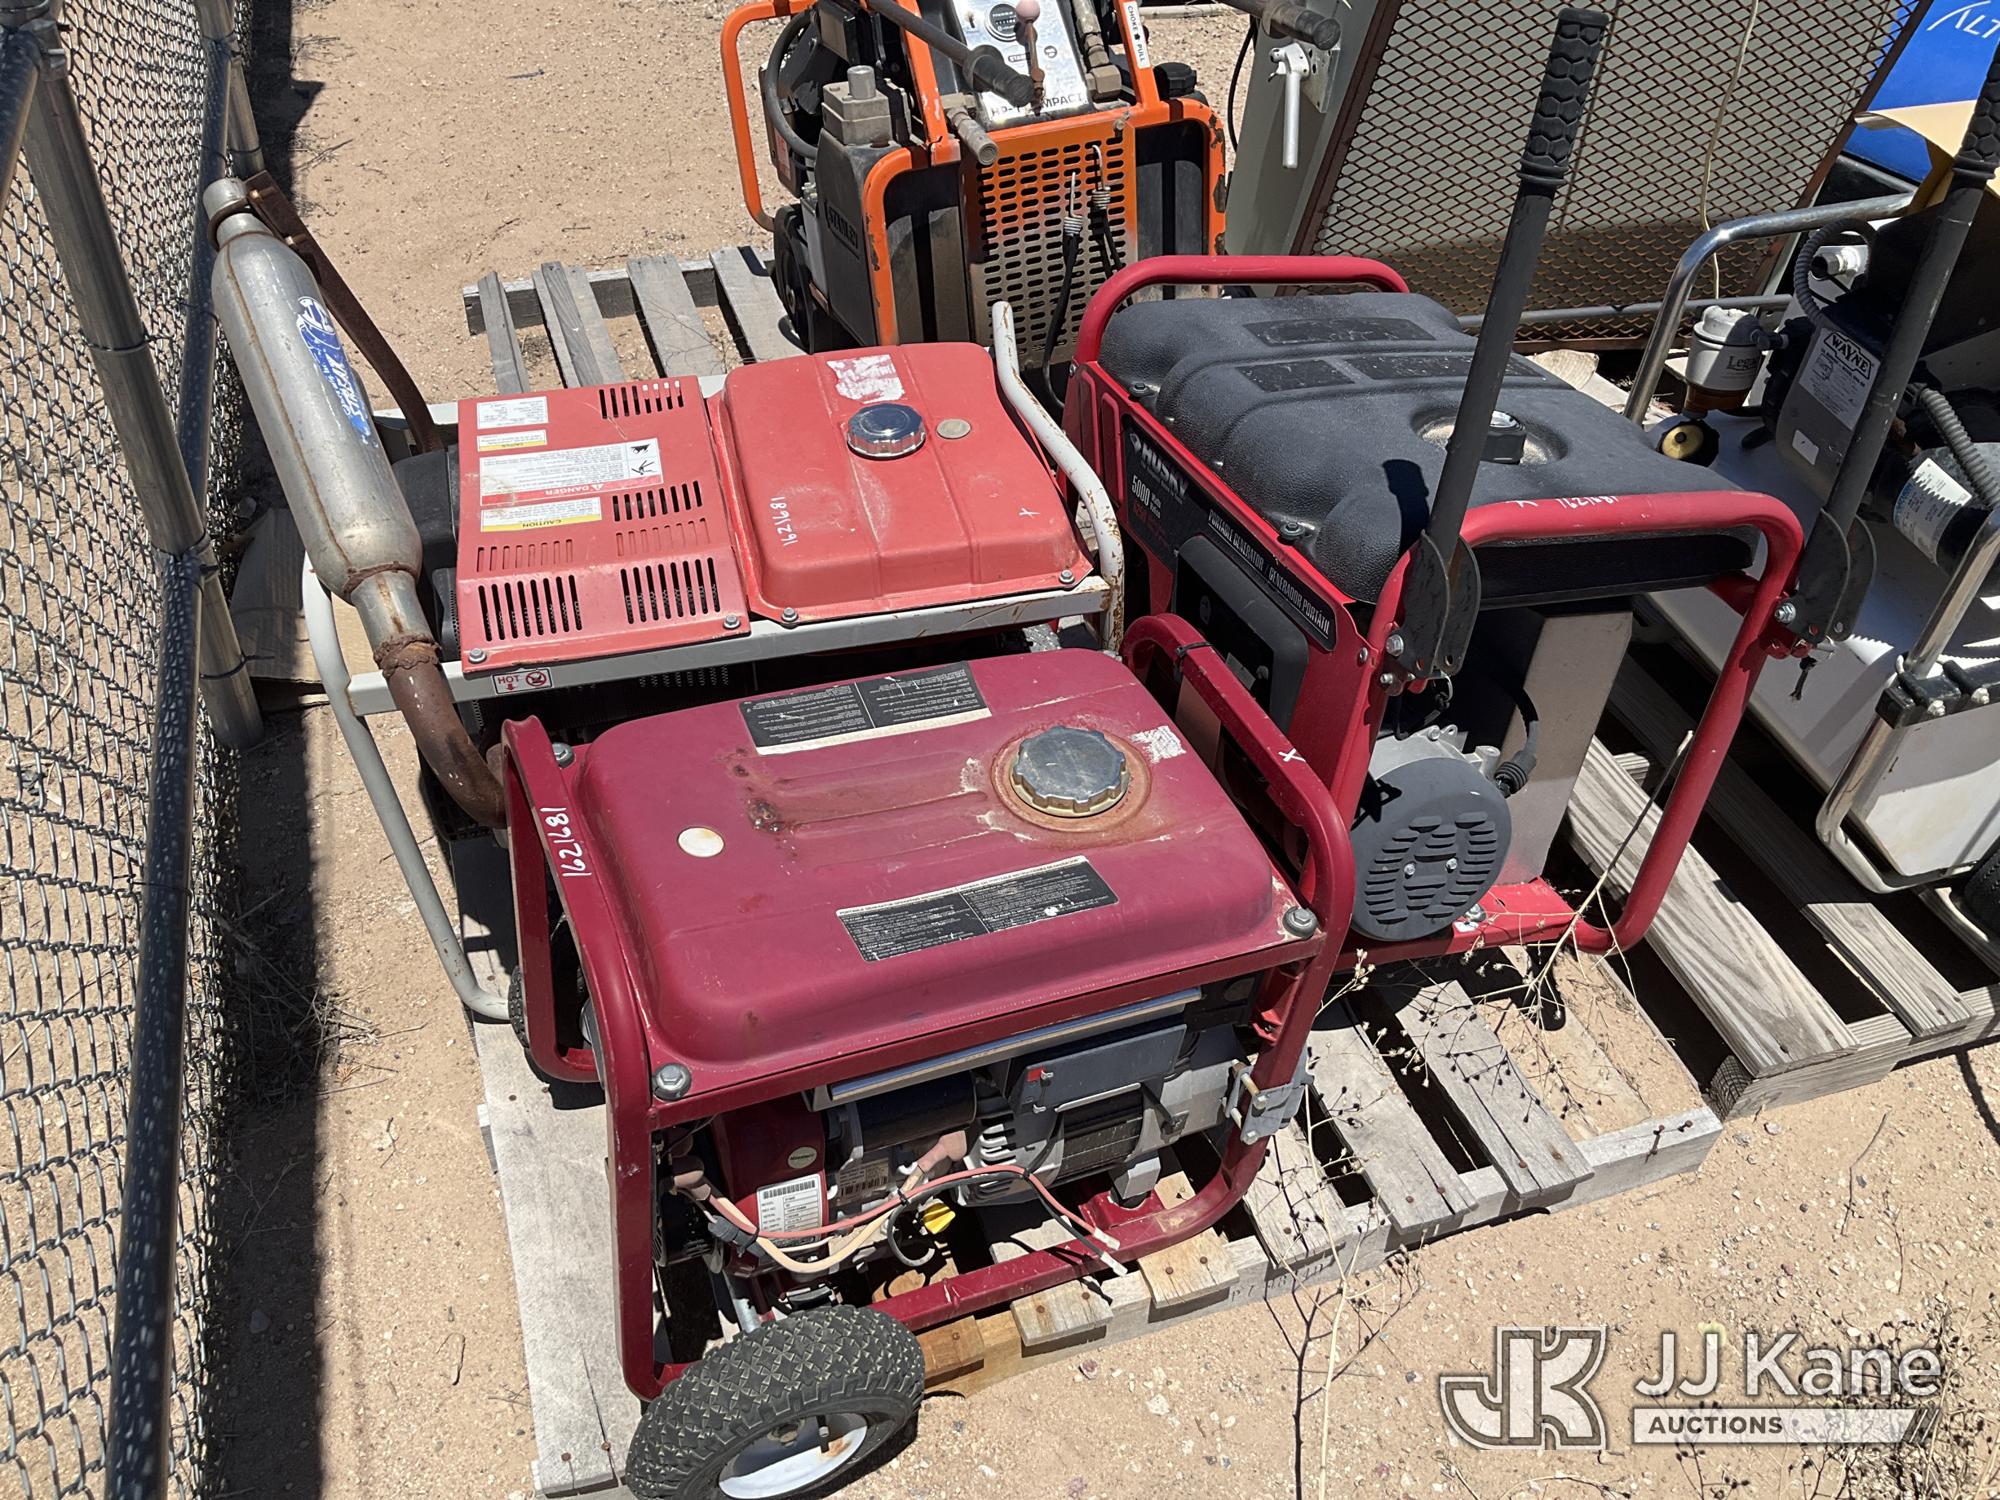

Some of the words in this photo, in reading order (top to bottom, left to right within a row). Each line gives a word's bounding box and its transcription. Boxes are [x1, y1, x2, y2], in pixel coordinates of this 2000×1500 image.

[1126, 5, 1139, 35] CHOKE
[1137, 44, 1146, 62] PULL
[1832, 334, 1869, 373] WAYNE
[545, 486, 590, 496] DANGER
[1131, 475, 1151, 507] 5000
[1141, 443, 1189, 496] HUSKY
[522, 519, 562, 528] CAUTION
[770, 496, 798, 546] 1621681
[1208, 509, 1234, 541] PORTABLE
[1233, 536, 1265, 571] GENERATOR
[1268, 568, 1303, 608] GENERADOR
[1301, 598, 1331, 636] PORTÁTIL
[498, 675, 520, 684] HOT
[540, 807, 592, 877] 1621681
